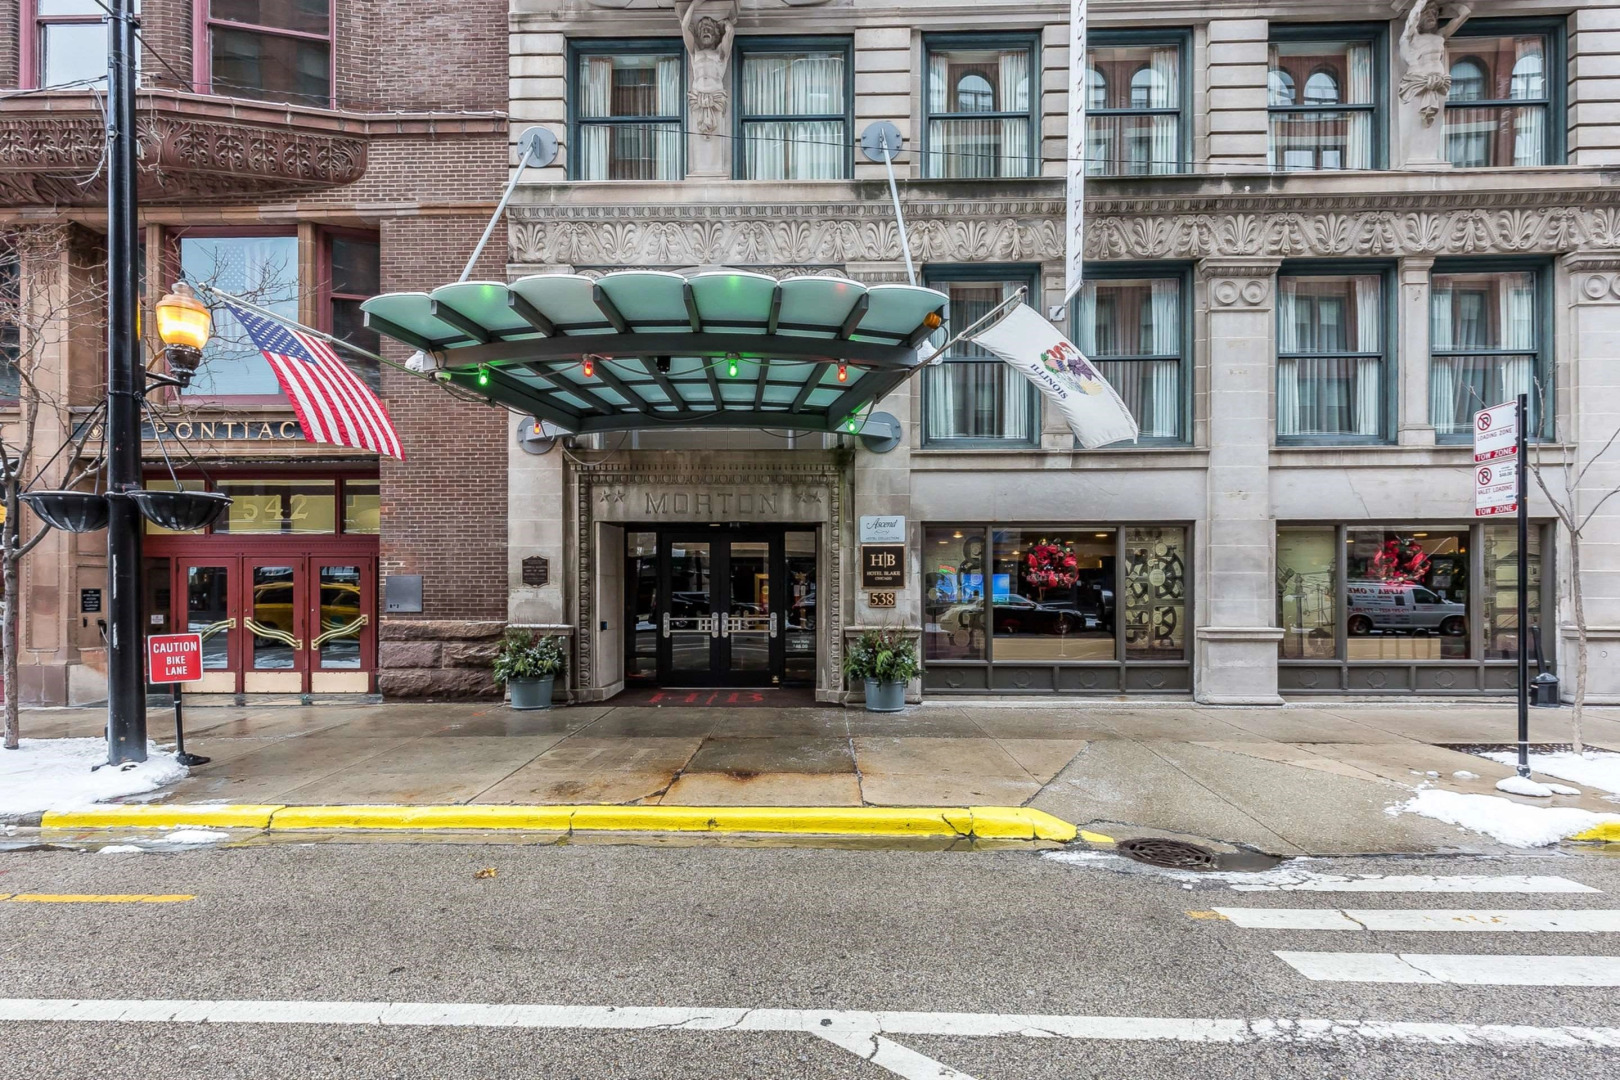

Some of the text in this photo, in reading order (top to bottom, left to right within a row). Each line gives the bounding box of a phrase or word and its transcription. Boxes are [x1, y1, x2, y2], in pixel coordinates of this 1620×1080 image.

[1030, 363, 1068, 399] ILLINOIS
[155, 421, 296, 440] PONTIAC
[1477, 427, 1512, 442] LOADING ZONE
[1477, 447, 1513, 461] TOW ZONE
[1477, 484, 1513, 495] VALET LOADING
[242, 494, 309, 520] 542
[645, 492, 777, 514] MORTON
[1477, 504, 1513, 516] TOW ZONE
[866, 517, 898, 530] Ascend
[870, 592, 894, 605] 538
[153, 641, 198, 654] CAUTION
[166, 655, 186, 665] BIKE
[165, 665, 188, 676] LANE
